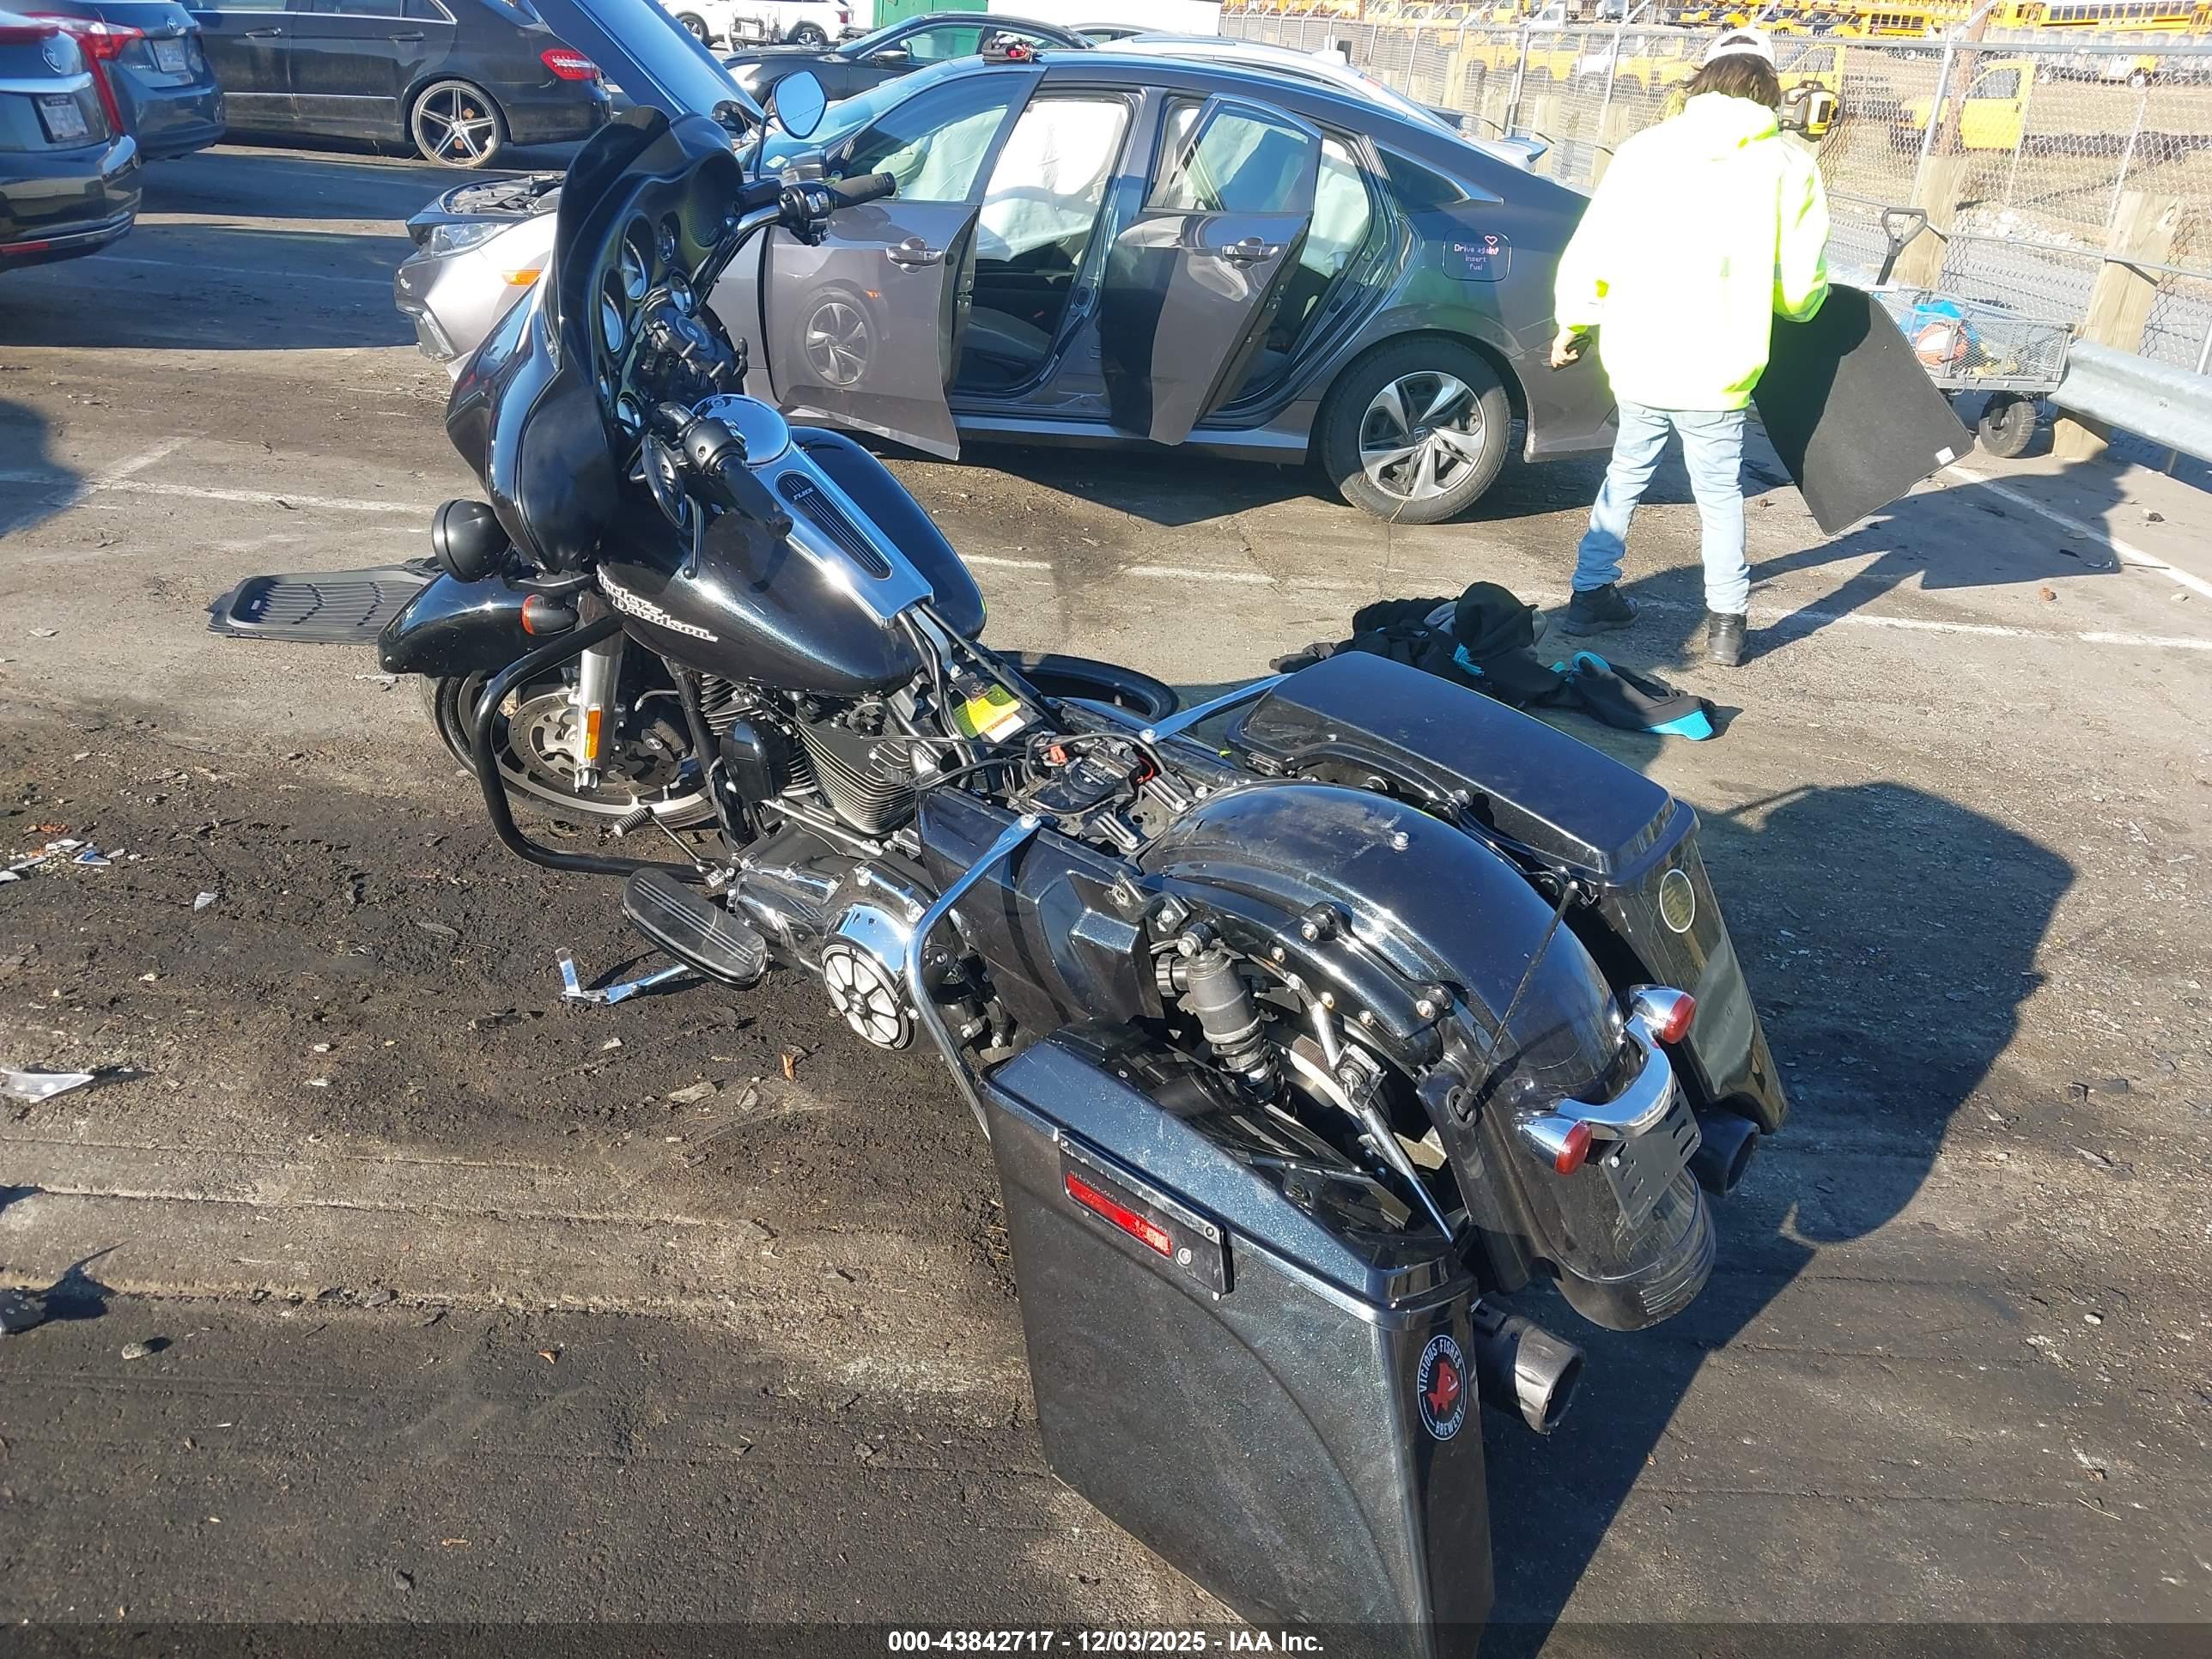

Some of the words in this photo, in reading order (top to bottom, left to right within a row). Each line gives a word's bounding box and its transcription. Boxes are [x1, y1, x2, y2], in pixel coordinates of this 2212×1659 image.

[1454, 243, 1475, 253] Drive
[1477, 245, 1499, 255] again?
[1469, 263, 1483, 271] fuel
[611, 595, 720, 643] Davidson
[1419, 1343, 1438, 1393] VICIOUS
[1438, 1339, 1462, 1370] FISHES
[1435, 1404, 1463, 1436] BREWERY
